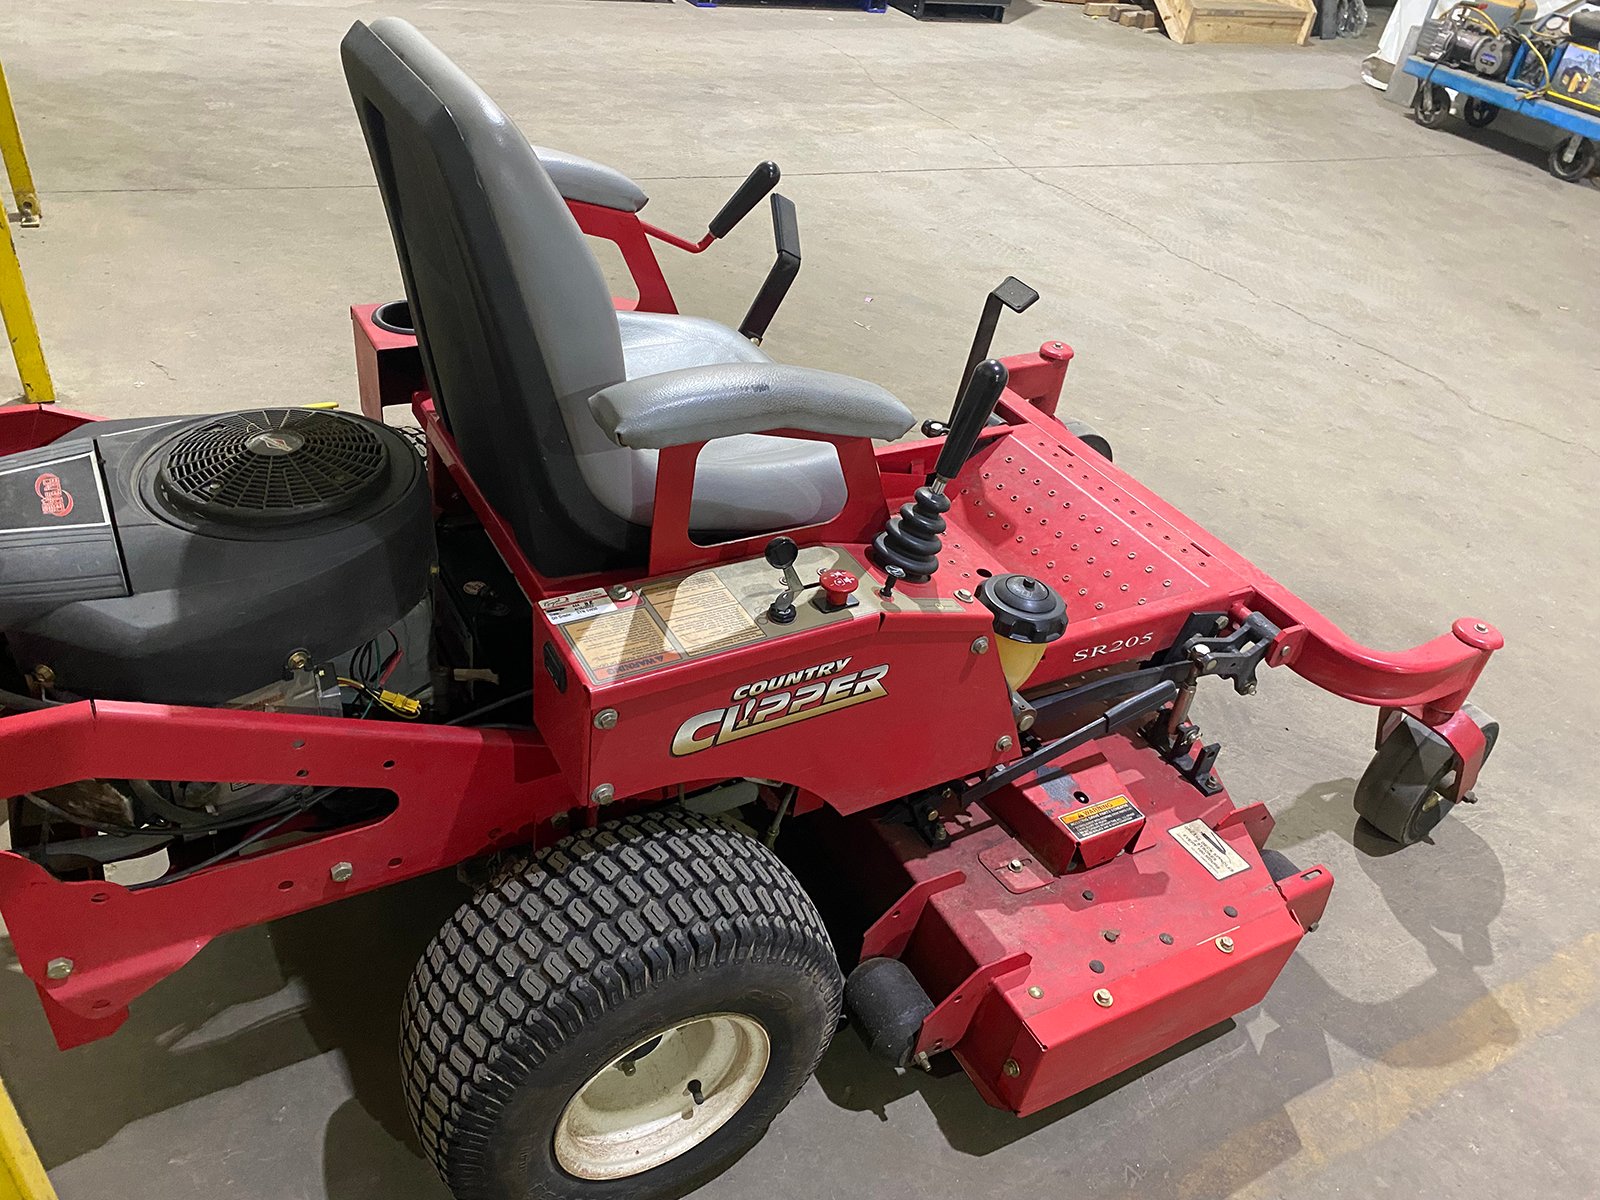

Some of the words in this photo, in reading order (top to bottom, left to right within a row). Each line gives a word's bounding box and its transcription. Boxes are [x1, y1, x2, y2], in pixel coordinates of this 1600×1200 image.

[1072, 632, 1154, 662] SR205
[607, 655, 656, 675] WARNING
[732, 656, 853, 701] COUNTRY
[670, 663, 890, 757] CLIPPER
[1084, 803, 1113, 816] WARNING
